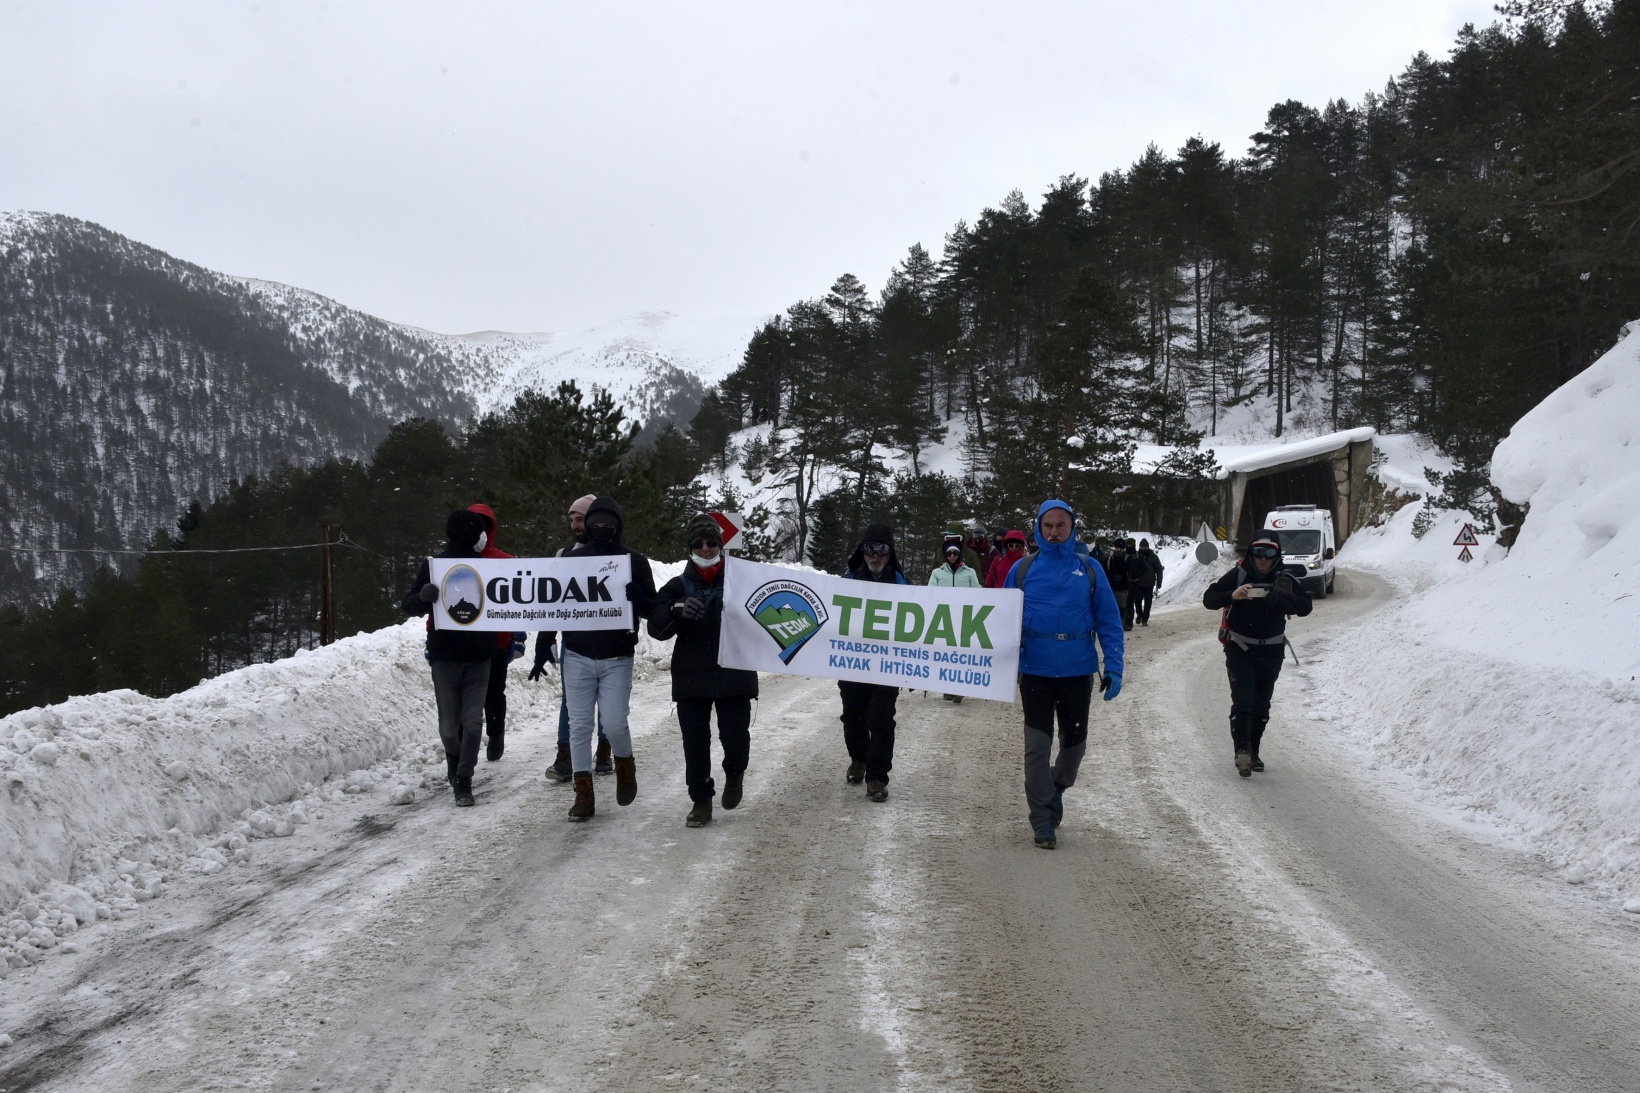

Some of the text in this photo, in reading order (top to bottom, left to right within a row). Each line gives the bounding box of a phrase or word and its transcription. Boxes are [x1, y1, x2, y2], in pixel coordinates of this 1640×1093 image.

[486, 570, 613, 604] GÜDAK
[749, 591, 767, 610] TRABZON
[765, 583, 780, 593] TENİS
[780, 582, 804, 594] DAĞCILIK
[803, 591, 817, 605] KAYAK
[487, 607, 622, 621] Gümüşhane Dağcılık ve Doğa Sporları Kulübü
[767, 617, 811, 640] TEDAK
[832, 594, 995, 649] TEDAK
[829, 639, 993, 668] TRABZON TENİS DAĞCILIK
[829, 655, 991, 687] KAYAK İHTİSAS KULÜBÜ
